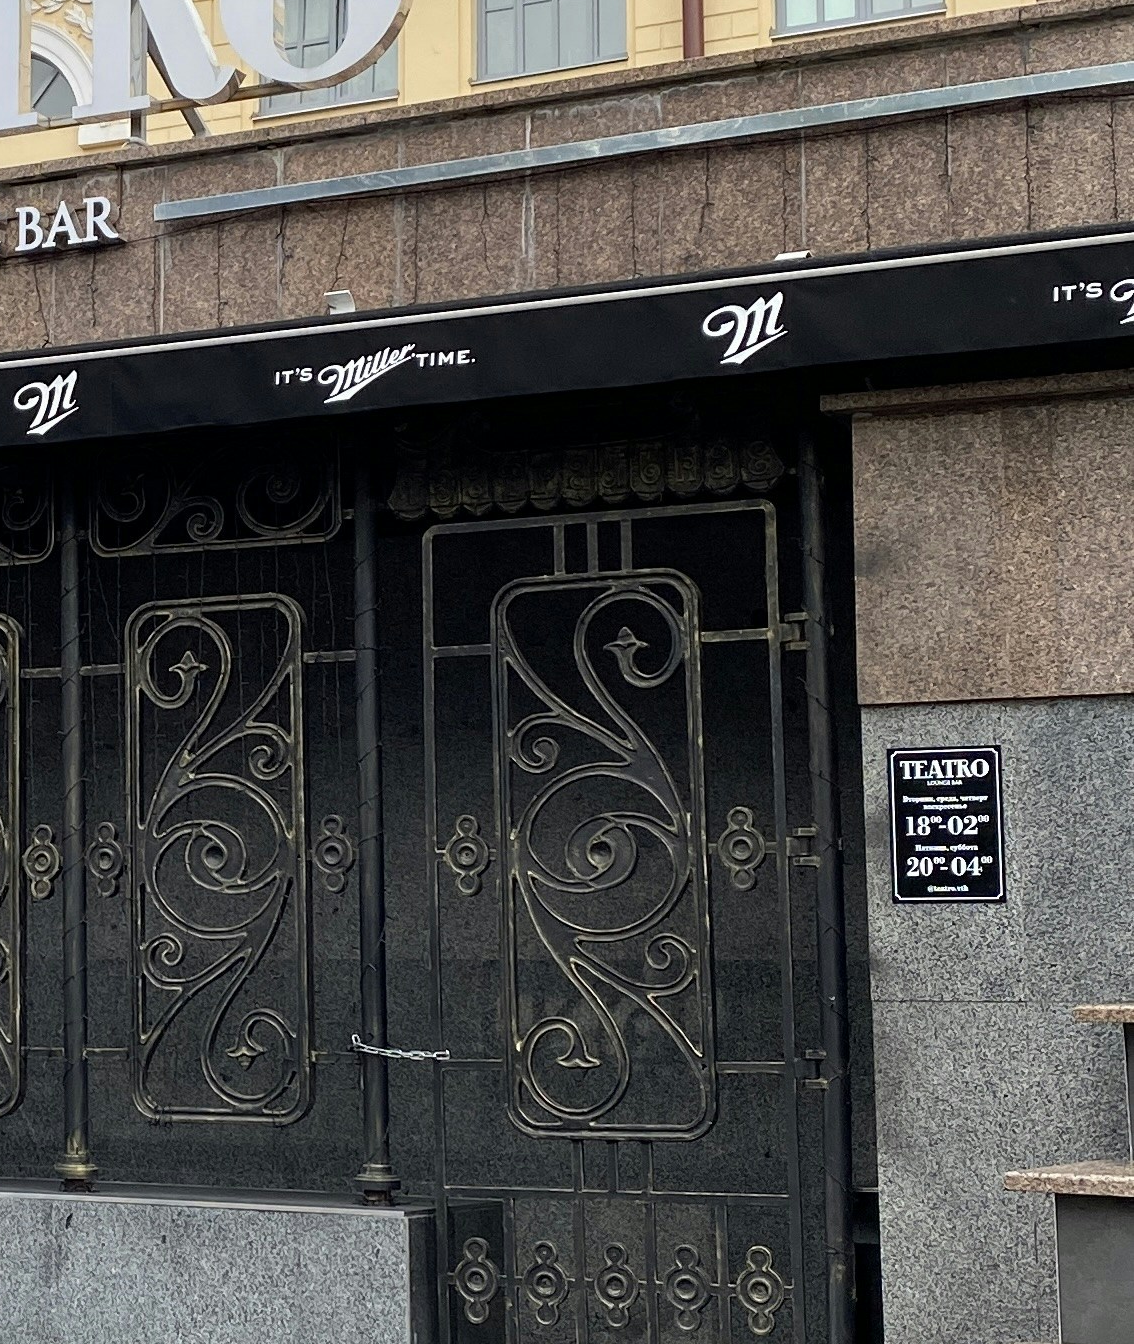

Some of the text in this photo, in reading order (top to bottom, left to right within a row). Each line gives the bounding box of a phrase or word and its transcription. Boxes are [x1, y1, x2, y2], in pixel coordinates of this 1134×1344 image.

[15, 196, 119, 252] BAR
[1053, 282, 1103, 302] IT'S
[275, 343, 476, 404] IT'S Miller TIME.
[900, 758, 990, 779] TEATRO
